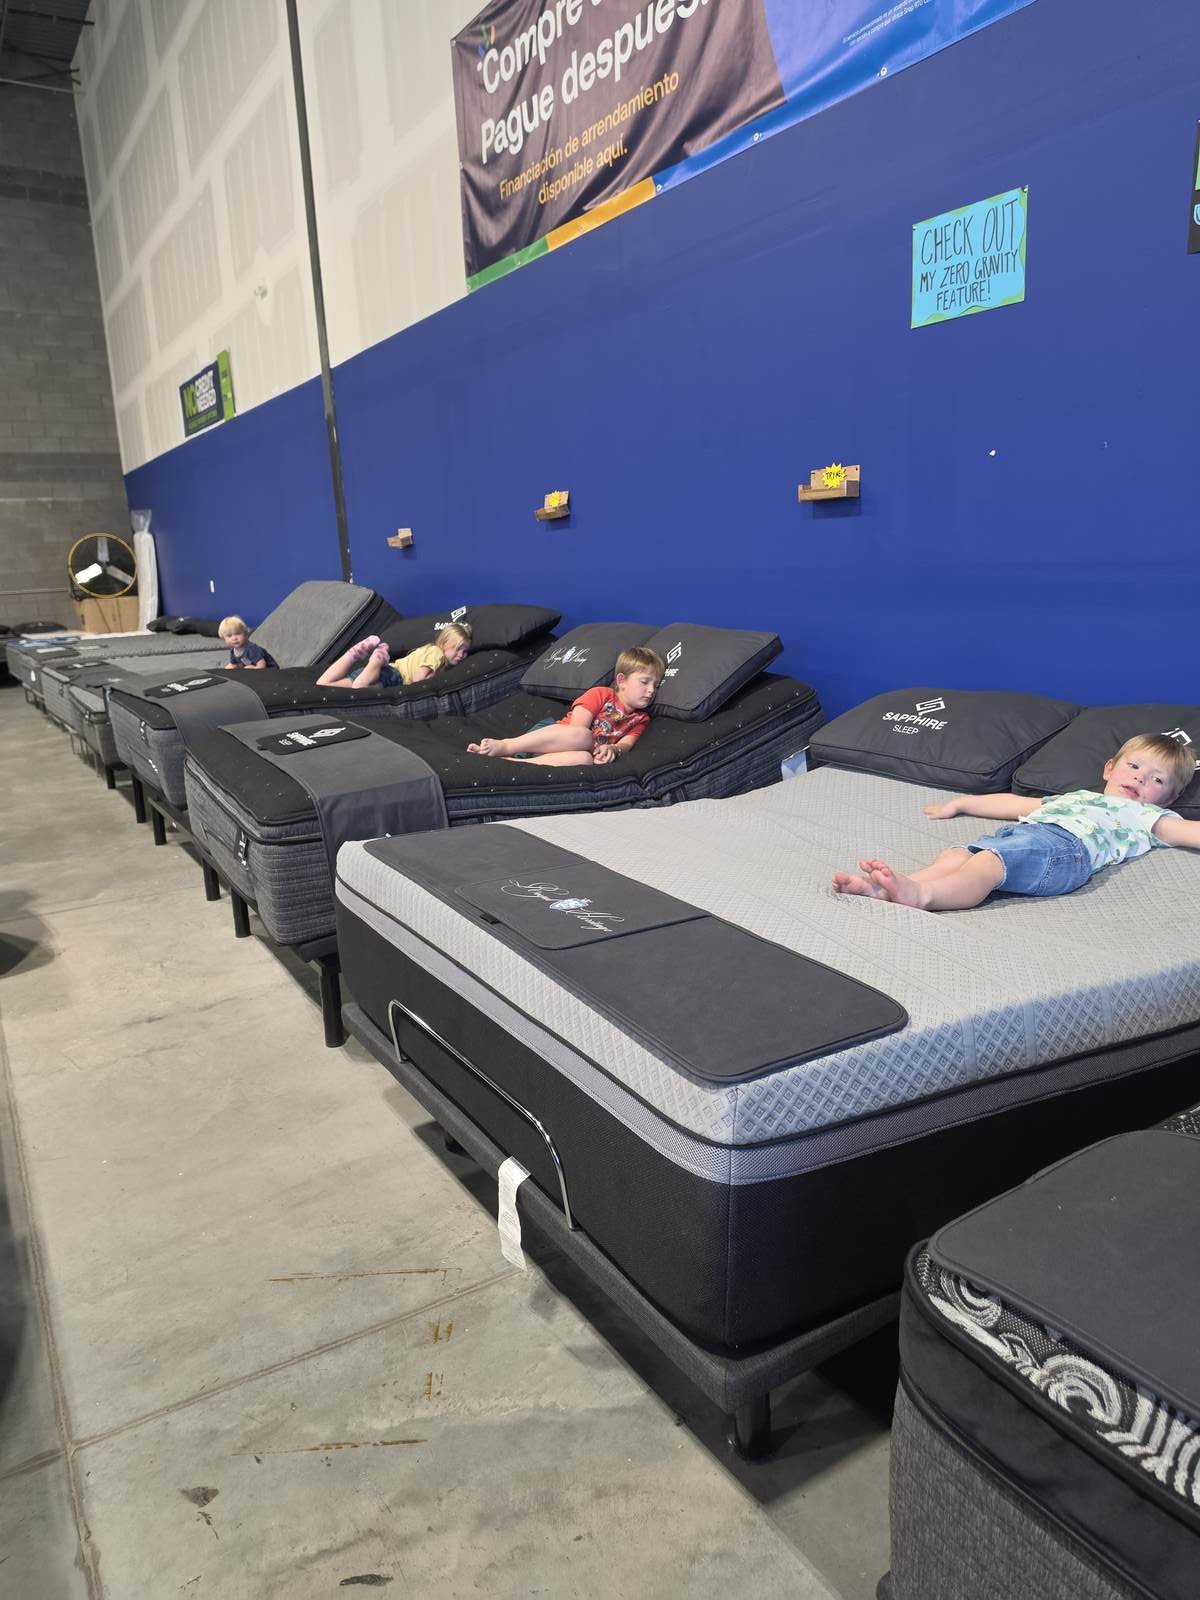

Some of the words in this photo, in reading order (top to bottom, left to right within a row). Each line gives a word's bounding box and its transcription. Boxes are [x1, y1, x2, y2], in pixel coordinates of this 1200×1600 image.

[481, 85, 554, 164] Pague
[500, 149, 563, 200] Financiación
[565, 136, 579, 157] de
[582, 72, 679, 146] arrendamiento
[538, 157, 593, 204] disponible
[596, 133, 628, 167] aquí.
[921, 216, 973, 265] CHECK
[982, 198, 1018, 253] OUT
[920, 270, 936, 292] MY
[940, 261, 969, 288] ZERO
[975, 249, 1018, 280] GRAVITY
[936, 279, 991, 311] FEATURE!
[882, 711, 948, 730] SAPPHIRE
[892, 724, 919, 735] SLEEP
